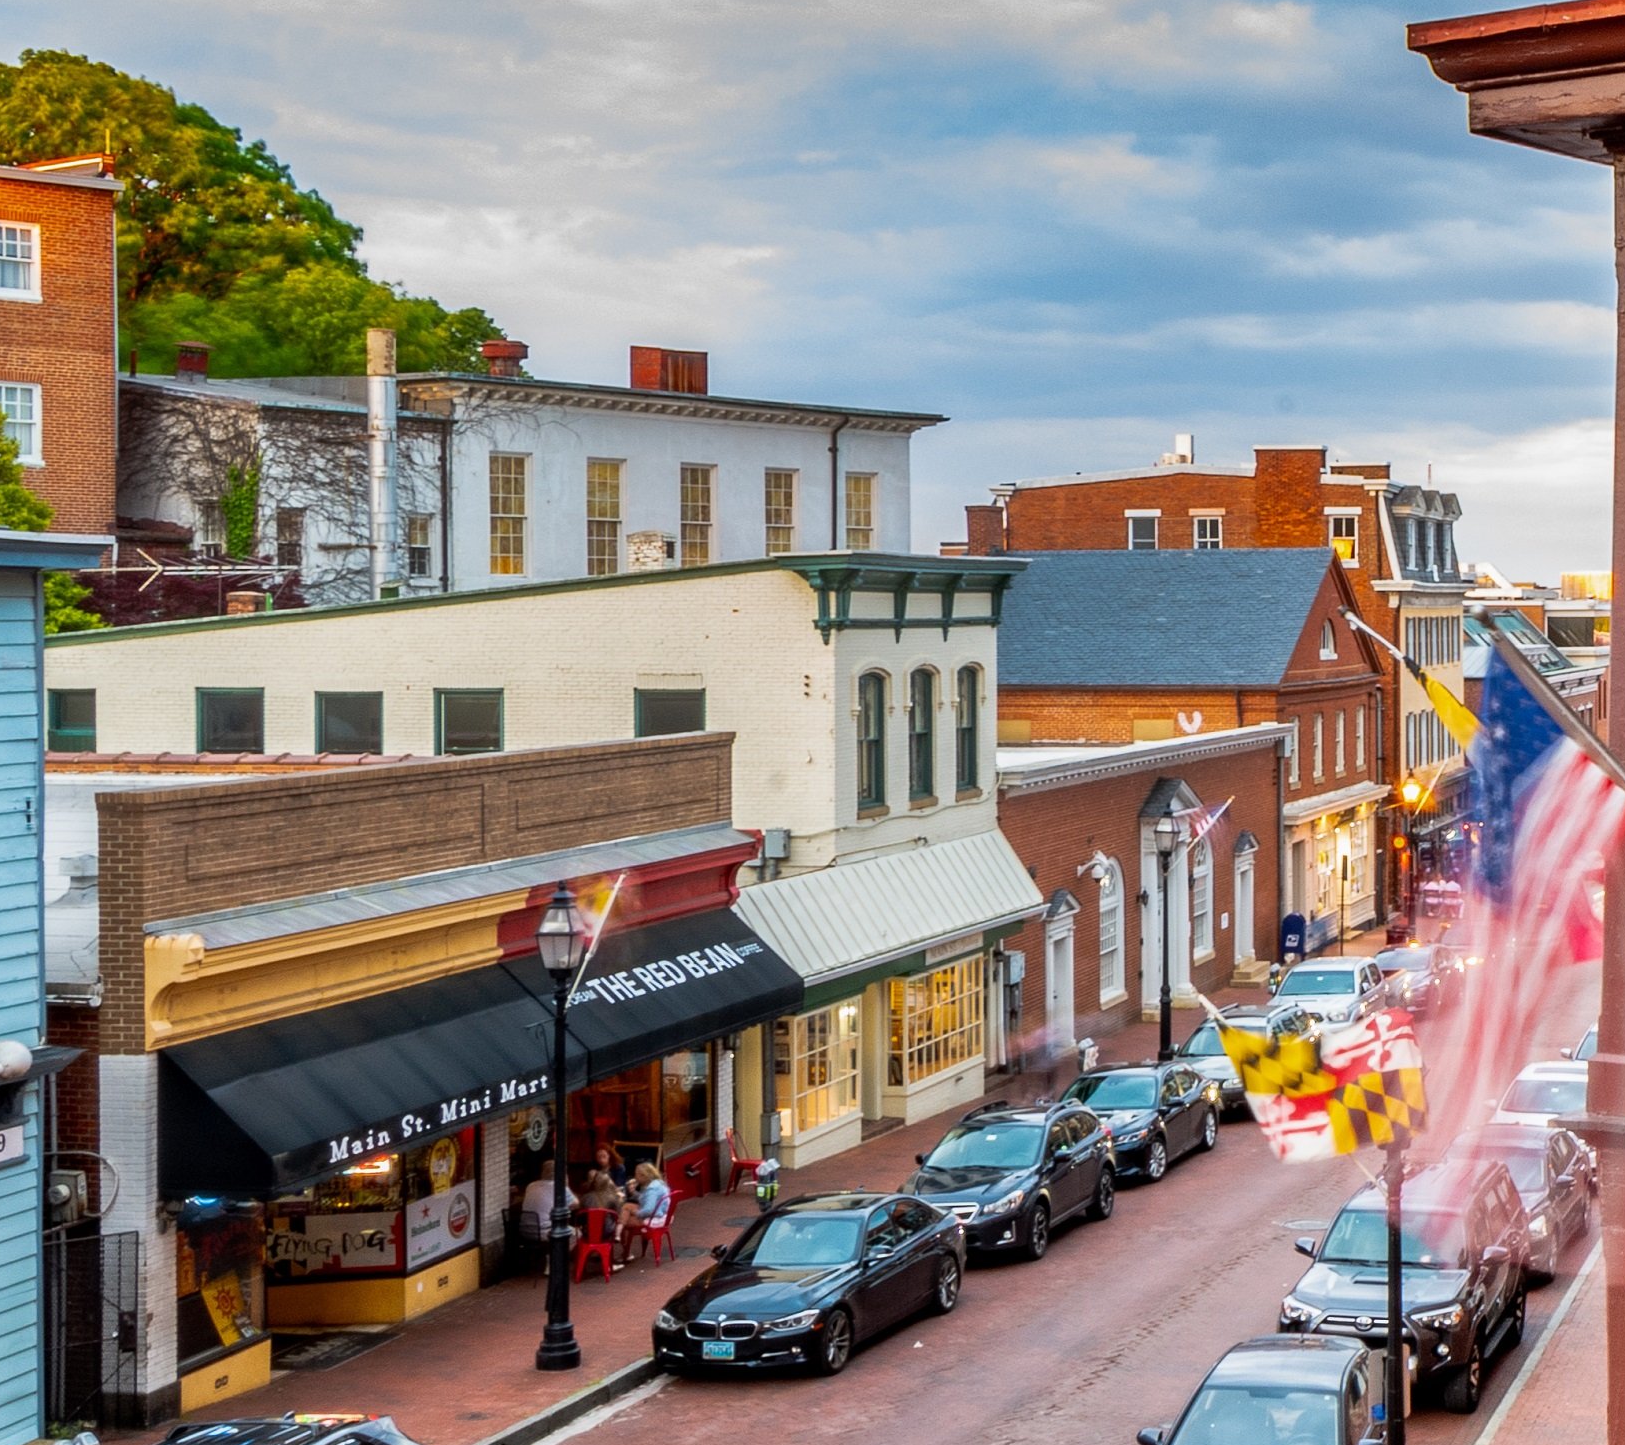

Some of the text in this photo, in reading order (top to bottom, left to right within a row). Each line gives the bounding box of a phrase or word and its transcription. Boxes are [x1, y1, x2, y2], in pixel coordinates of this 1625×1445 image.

[586, 971, 646, 1004] THE
[632, 959, 687, 992] RED
[676, 942, 745, 979] BEAN
[329, 1074, 549, 1164] Main St. Mini Mart
